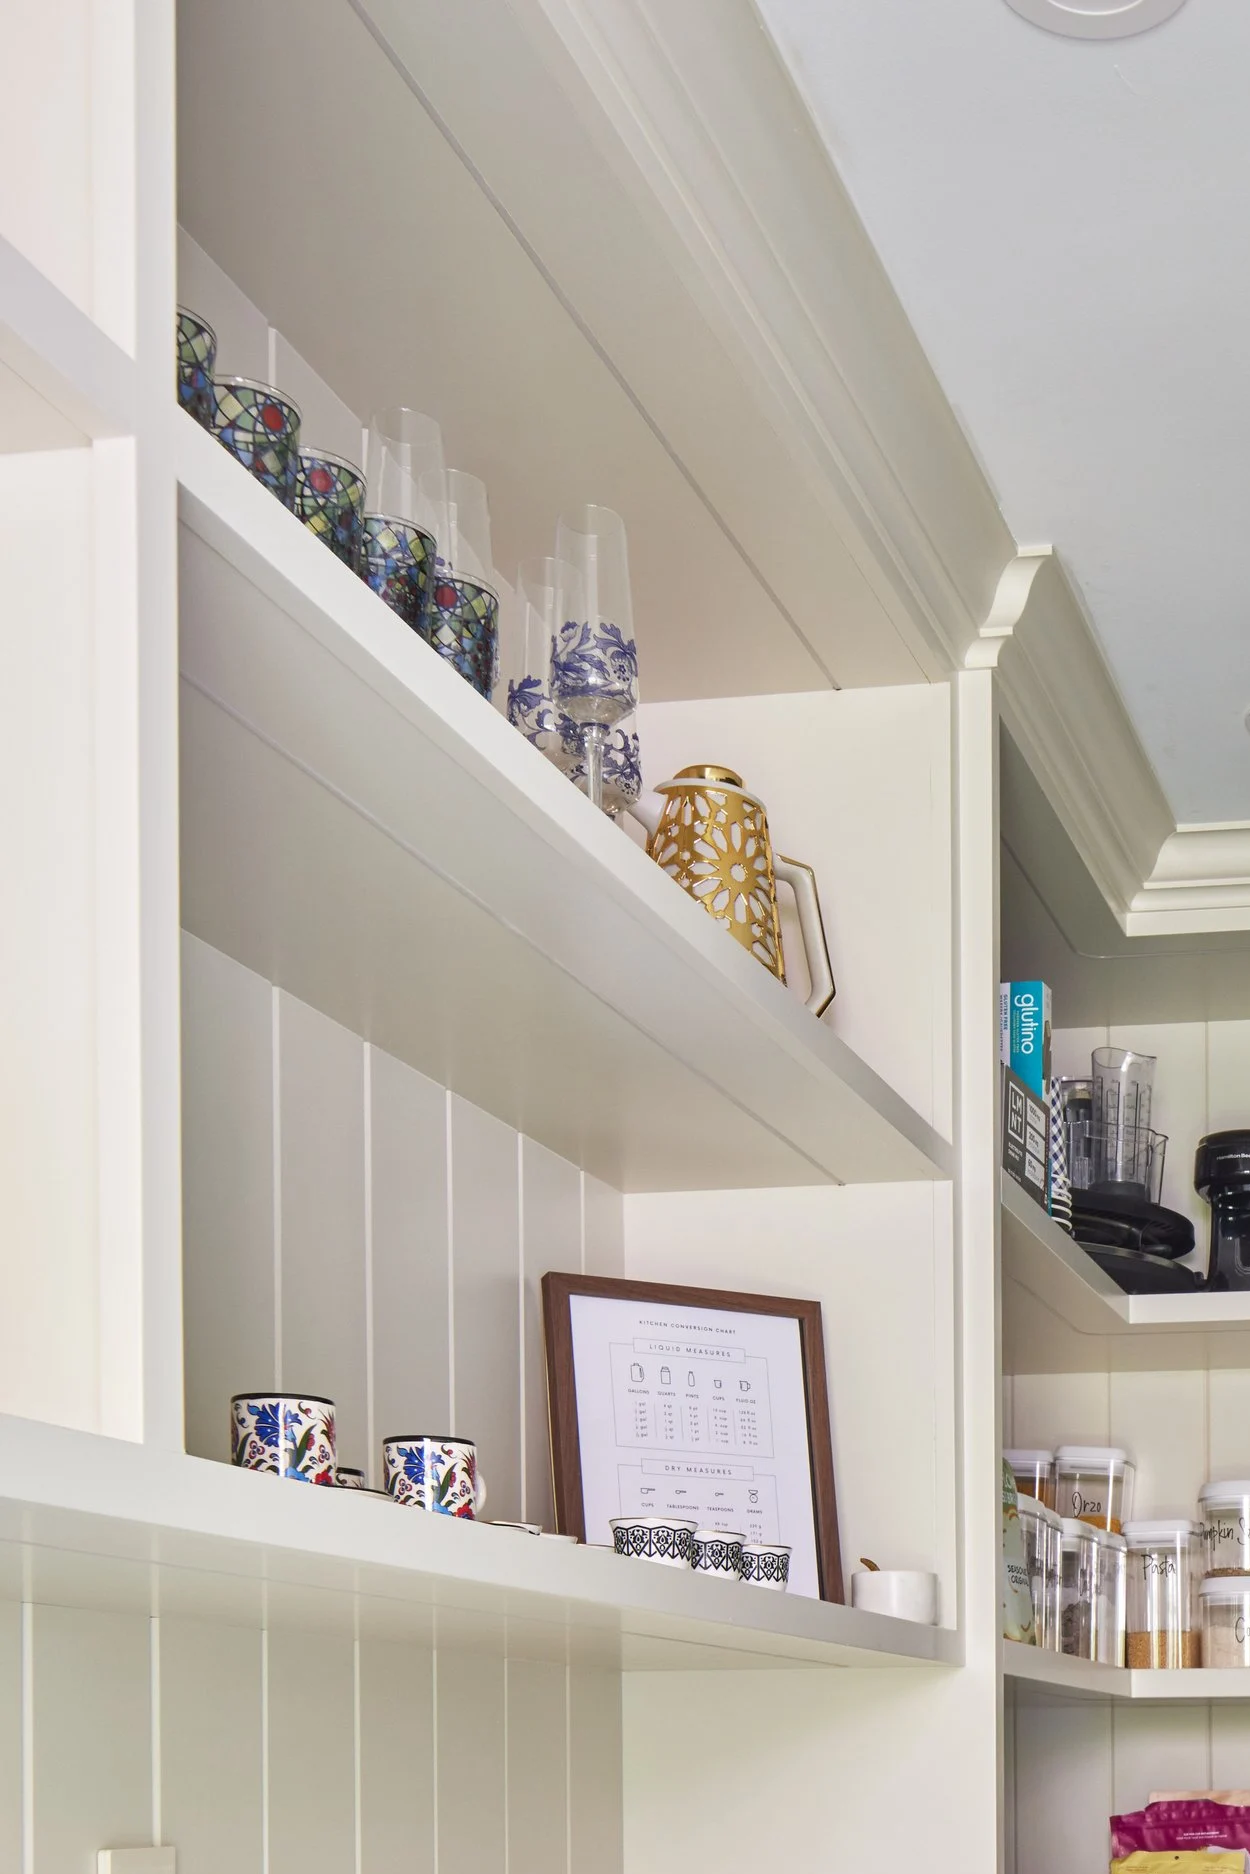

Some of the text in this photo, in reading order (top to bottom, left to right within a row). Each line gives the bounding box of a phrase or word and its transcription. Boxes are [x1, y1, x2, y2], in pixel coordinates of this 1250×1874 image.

[1014, 993, 1039, 1055] glutino
[670, 1322, 714, 1332] CONVERSION
[649, 1343, 731, 1358] LIQUID MEASURES
[686, 1466, 733, 1476] MEASURES
[1071, 1491, 1102, 1518] Orzo
[1141, 1554, 1176, 1581] Pasta
